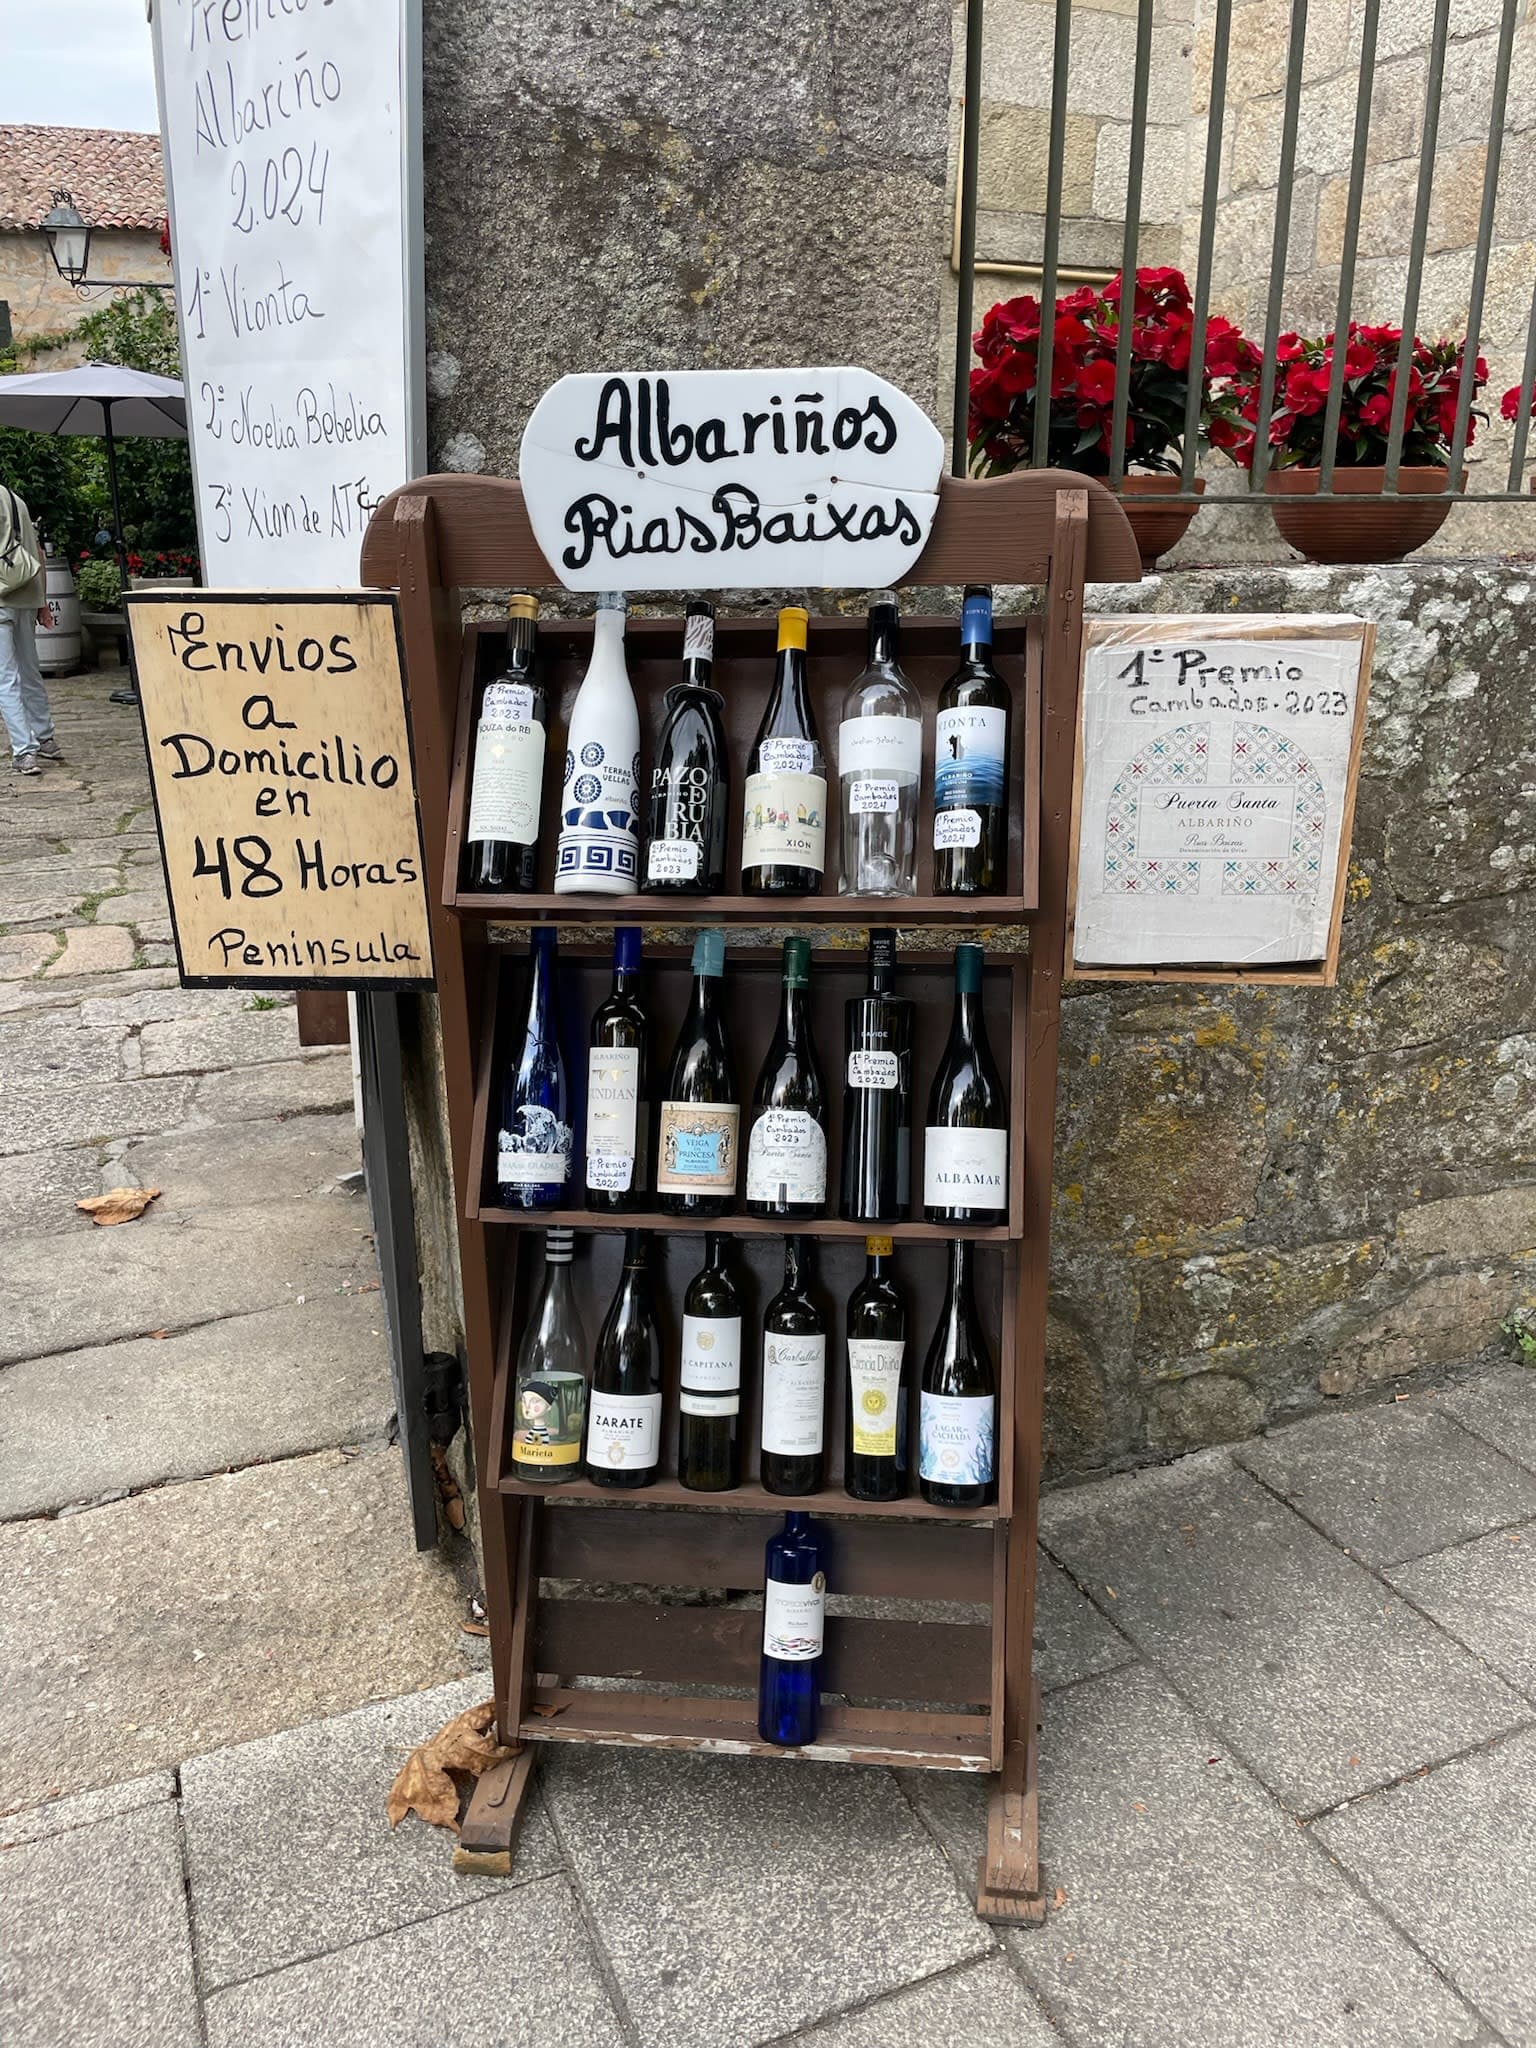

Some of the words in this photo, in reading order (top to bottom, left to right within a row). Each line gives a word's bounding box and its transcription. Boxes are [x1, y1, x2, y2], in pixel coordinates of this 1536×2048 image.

[195, 50, 341, 155] Albariño
[231, 140, 329, 233] 2.024
[220, 260, 325, 339] Vionta
[231, 384, 299, 450] Noelia
[575, 377, 897, 467] Albariños
[242, 487, 297, 539] Xion
[299, 494, 322, 534] de
[562, 493, 717, 570] Rias
[713, 483, 922, 552] Baixas
[167, 612, 357, 673] Envios
[1172, 649, 1304, 687] Premio
[485, 696, 528, 707] Cambados
[1285, 691, 1349, 716] 2023
[242, 695, 297, 730] a
[480, 723, 503, 733] OUZA
[518, 725, 531, 735] REI
[775, 740, 807, 751] Premio
[160, 733, 399, 789] Domicilio
[763, 749, 811, 762] Cambados
[603, 765, 632, 778] TERRAS
[773, 760, 803, 770] 2024
[652, 766, 708, 789] PAZO
[864, 783, 896, 792] Premio
[256, 787, 311, 816] en
[854, 791, 897, 802] Cambados
[1153, 791, 1220, 810] Puerta
[1226, 790, 1280, 812] Santa
[861, 800, 887, 810] 2024
[943, 814, 973, 824] Premio
[1177, 815, 1253, 828] ALBARIÑO
[786, 839, 812, 849] XION
[942, 833, 966, 843] 2024
[659, 842, 688, 853] Premio
[192, 835, 283, 899] 48
[296, 838, 418, 891] Horas
[656, 864, 681, 874] 2023
[208, 928, 421, 968] Peninsula
[852, 1065, 896, 1077] Cambados
[857, 1075, 886, 1085] 2022
[776, 1113, 807, 1123] Premio
[766, 1123, 807, 1134] Cambados
[774, 1133, 800, 1144] 2023
[679, 1150, 716, 1159] PRINCESA
[597, 1158, 627, 1168] Premio
[595, 1178, 619, 1188] 2020
[935, 1172, 1001, 1186] ALBAMAR
[689, 1359, 733, 1369] CAPITANA
[595, 1415, 644, 1429] ZARATE
[519, 1445, 554, 1458] Marieta
